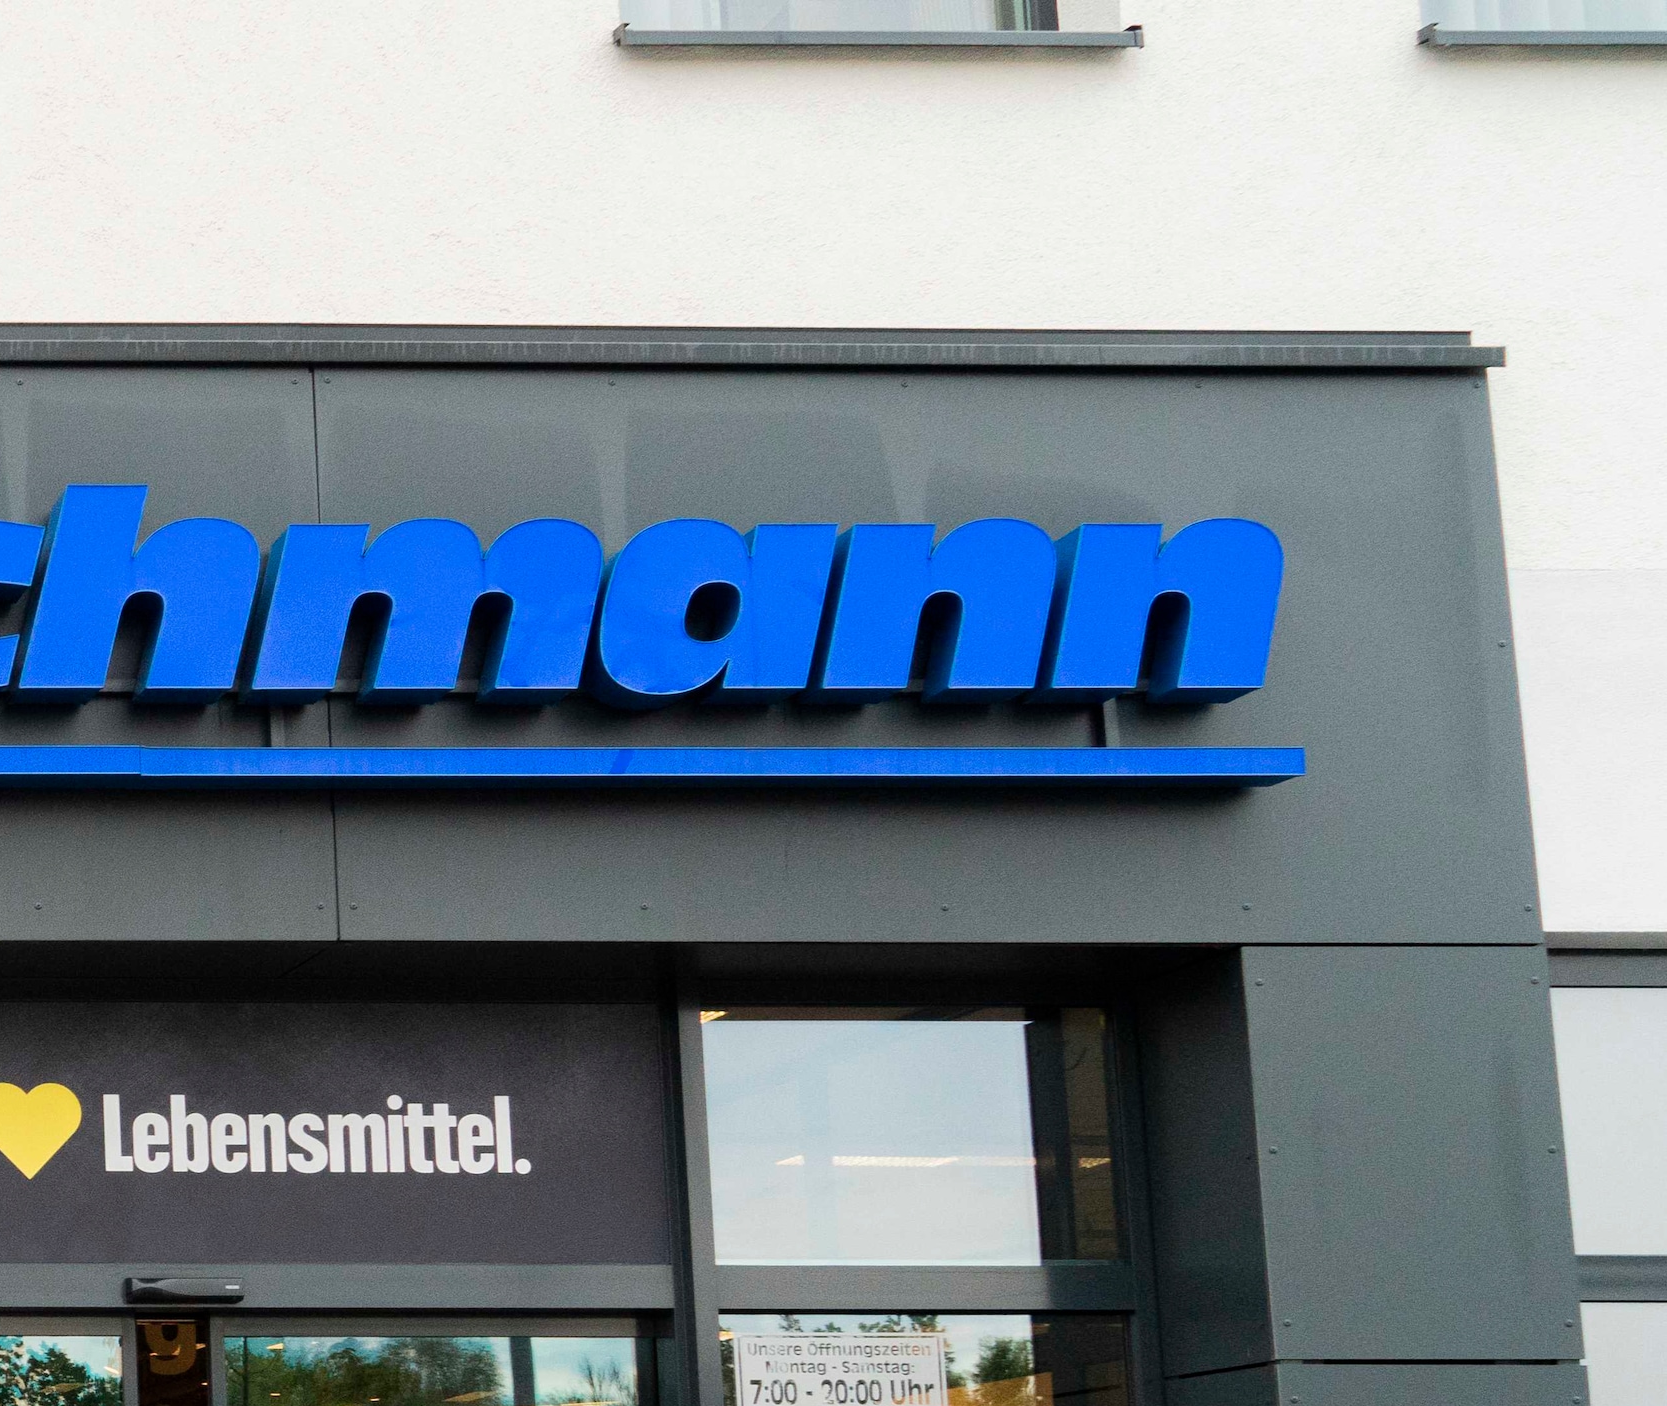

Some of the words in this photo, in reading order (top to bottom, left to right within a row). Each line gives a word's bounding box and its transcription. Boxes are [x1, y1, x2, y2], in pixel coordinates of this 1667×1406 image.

[103, 1094, 532, 1175] Lebensmittel.
[746, 1343, 802, 1356] Unsere
[807, 1341, 932, 1358] Öffnungszeiten
[765, 1360, 826, 1375] Montag
[842, 1361, 915, 1375] Samstag:
[750, 1379, 798, 1405] 7:00
[821, 1379, 882, 1405] 20:00
[890, 1379, 934, 1405] Uhr
